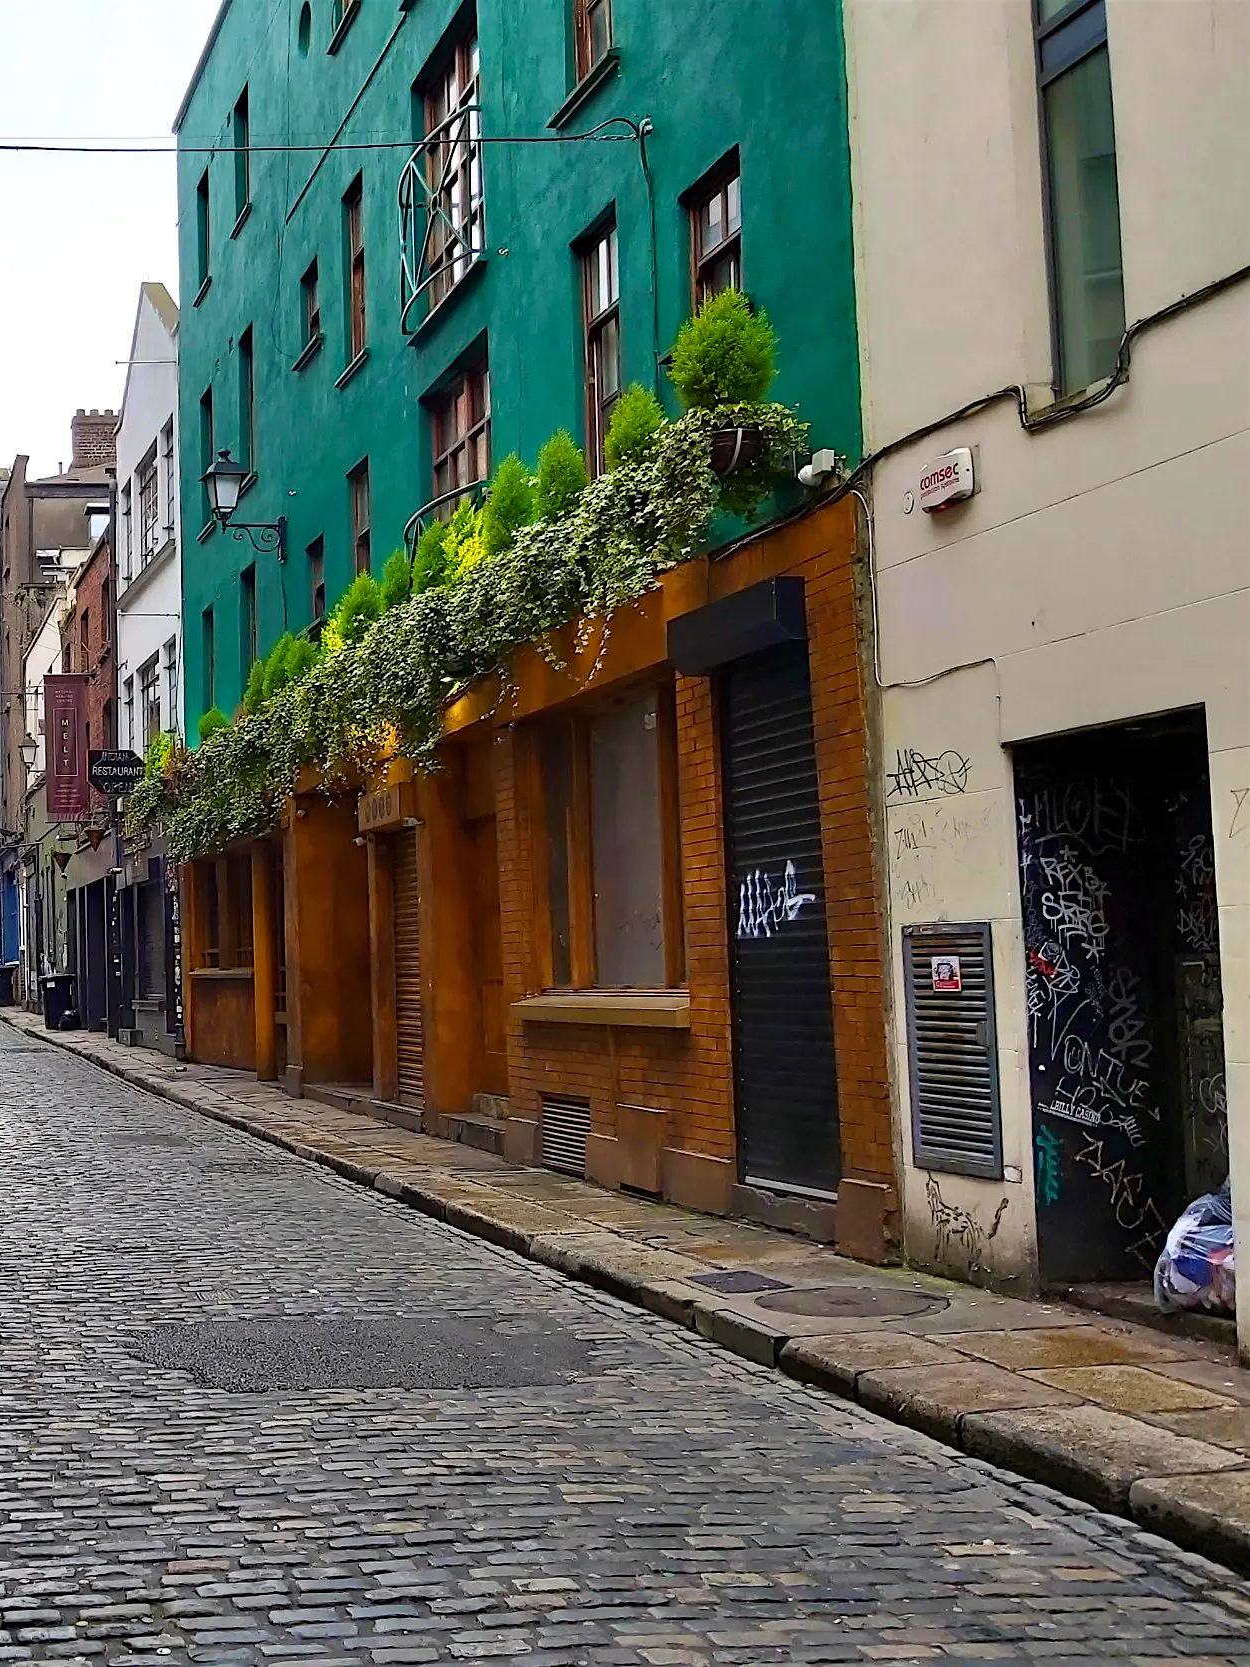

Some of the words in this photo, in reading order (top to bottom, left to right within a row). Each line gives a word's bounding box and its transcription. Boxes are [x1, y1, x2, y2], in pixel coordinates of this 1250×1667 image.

[919, 462, 959, 491] comsec
[60, 718, 70, 768] MELT
[92, 766, 143, 777] RESTAURANT
